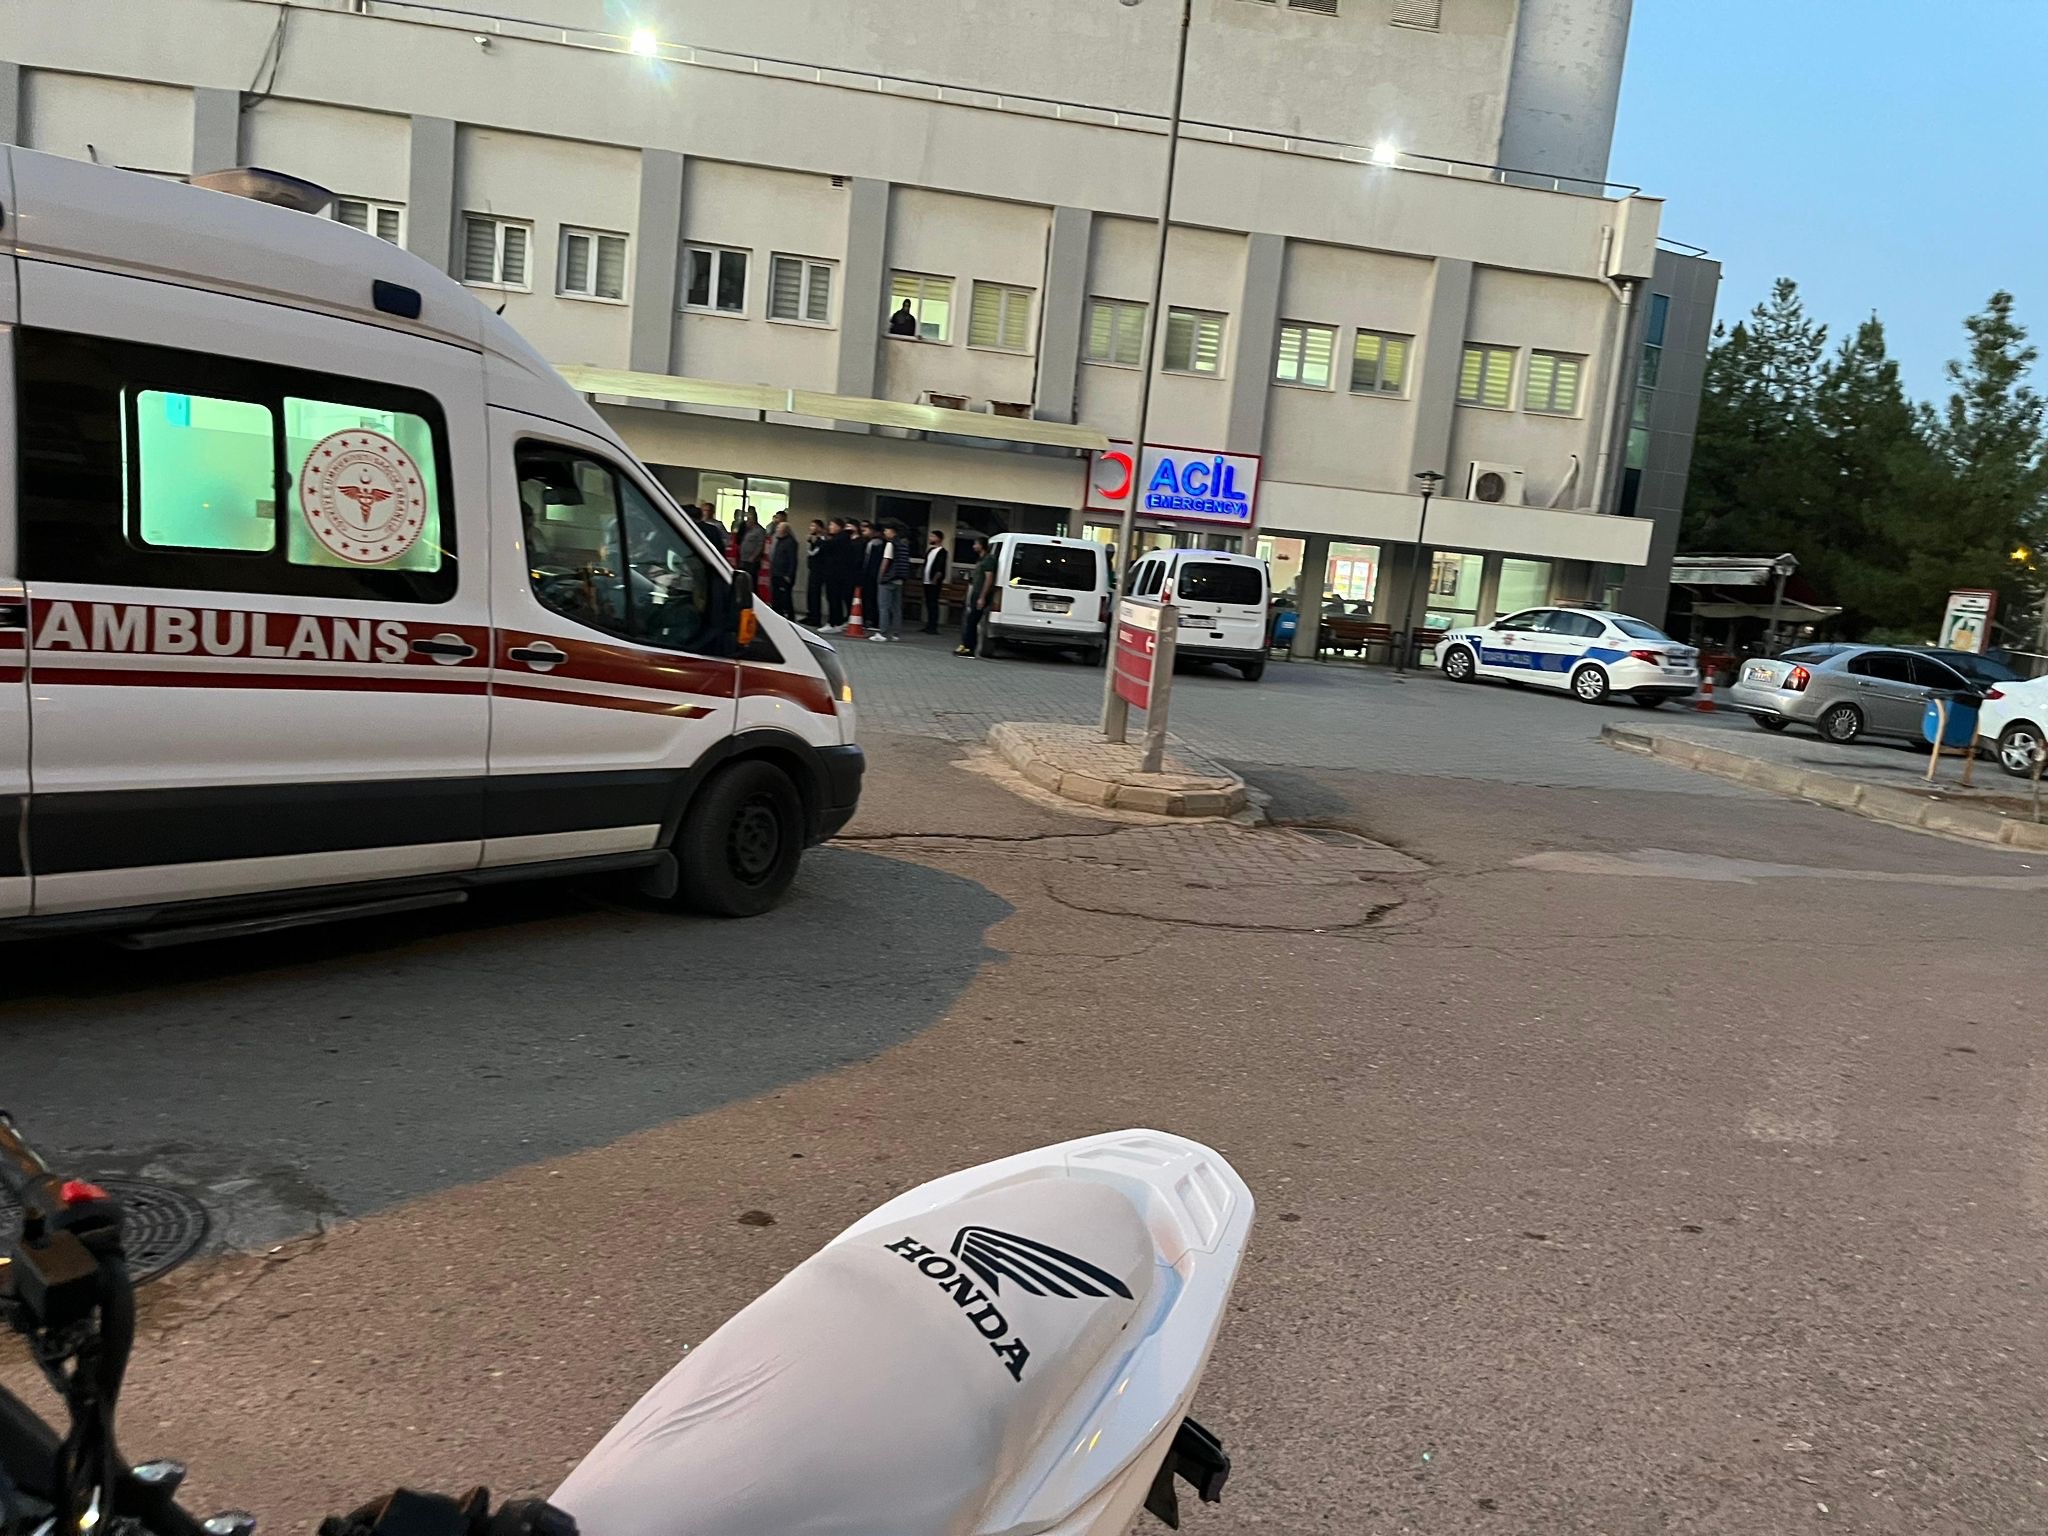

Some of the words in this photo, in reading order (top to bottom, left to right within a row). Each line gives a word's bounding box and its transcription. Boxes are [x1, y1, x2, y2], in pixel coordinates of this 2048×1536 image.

[1148, 455, 1246, 500] ACİL
[1145, 494, 1248, 518] (EMERGENCY)
[35, 601, 411, 664] AMBULANS
[884, 1236, 1031, 1382] HONDA
